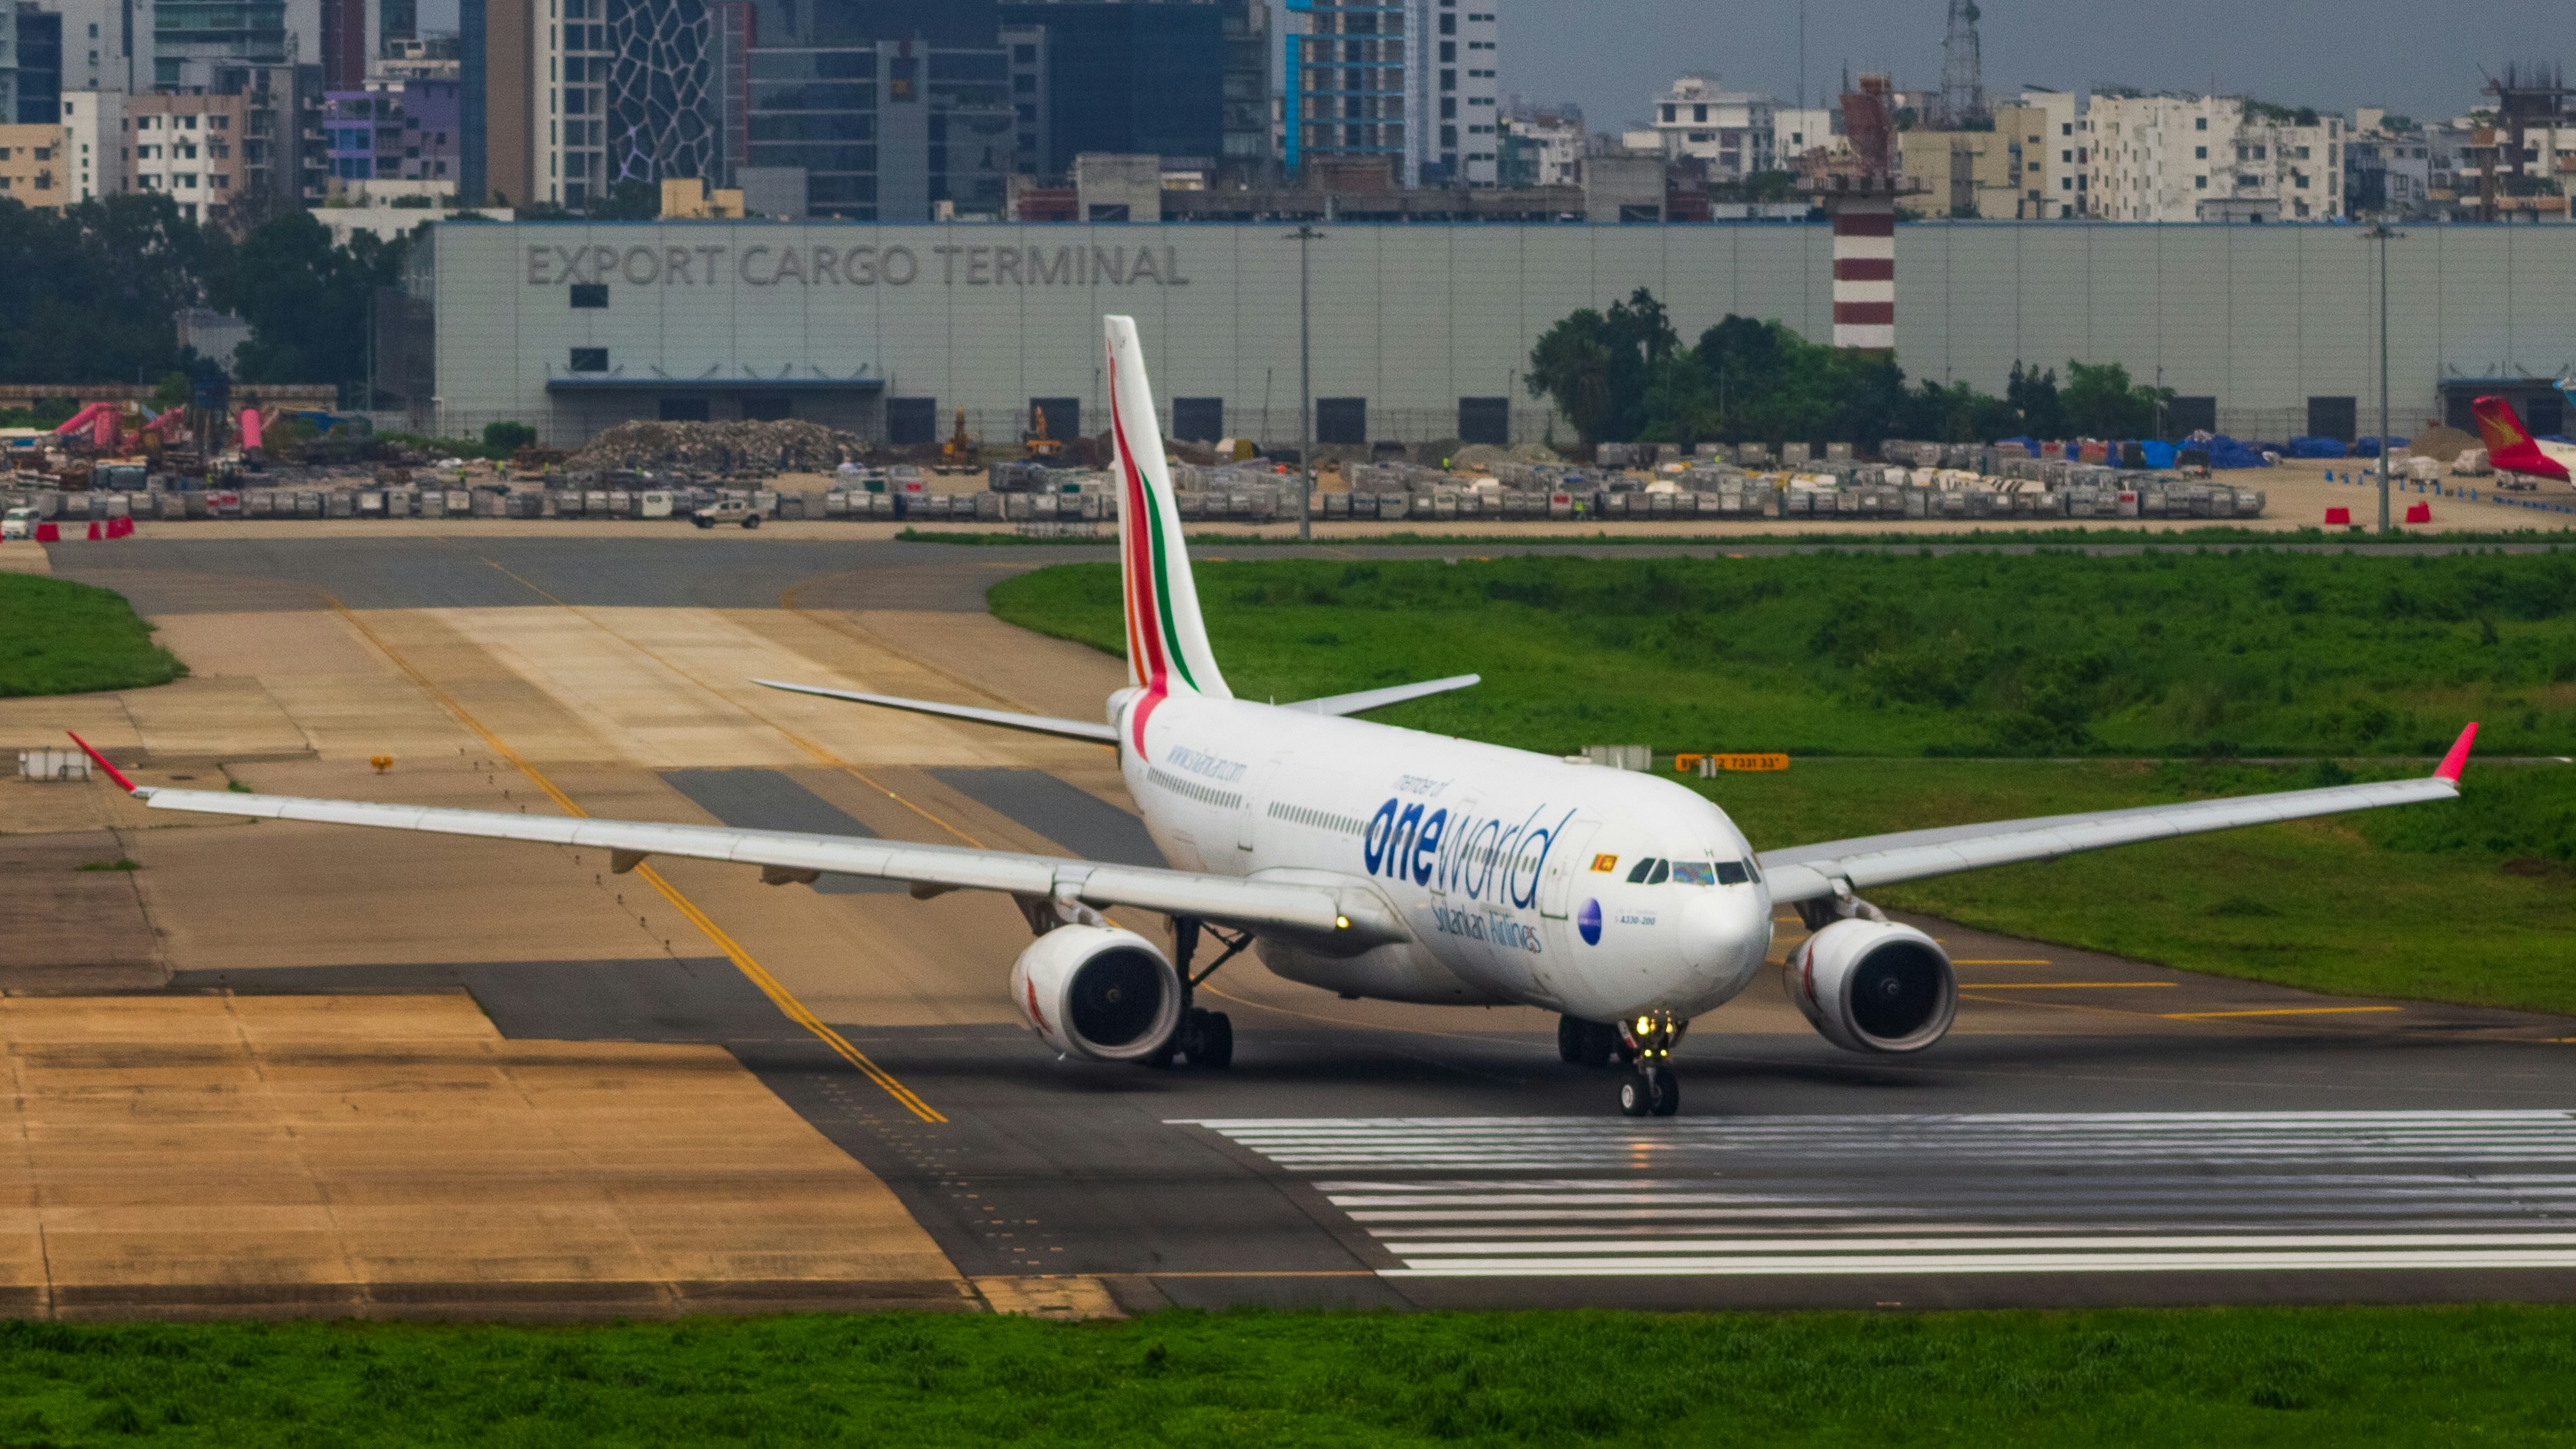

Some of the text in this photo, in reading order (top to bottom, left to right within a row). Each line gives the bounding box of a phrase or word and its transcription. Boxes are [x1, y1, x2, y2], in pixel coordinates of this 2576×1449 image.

[527, 244, 1190, 286] EXPORT CARGO TERMINAL
[1364, 798, 1577, 909] oneworld
